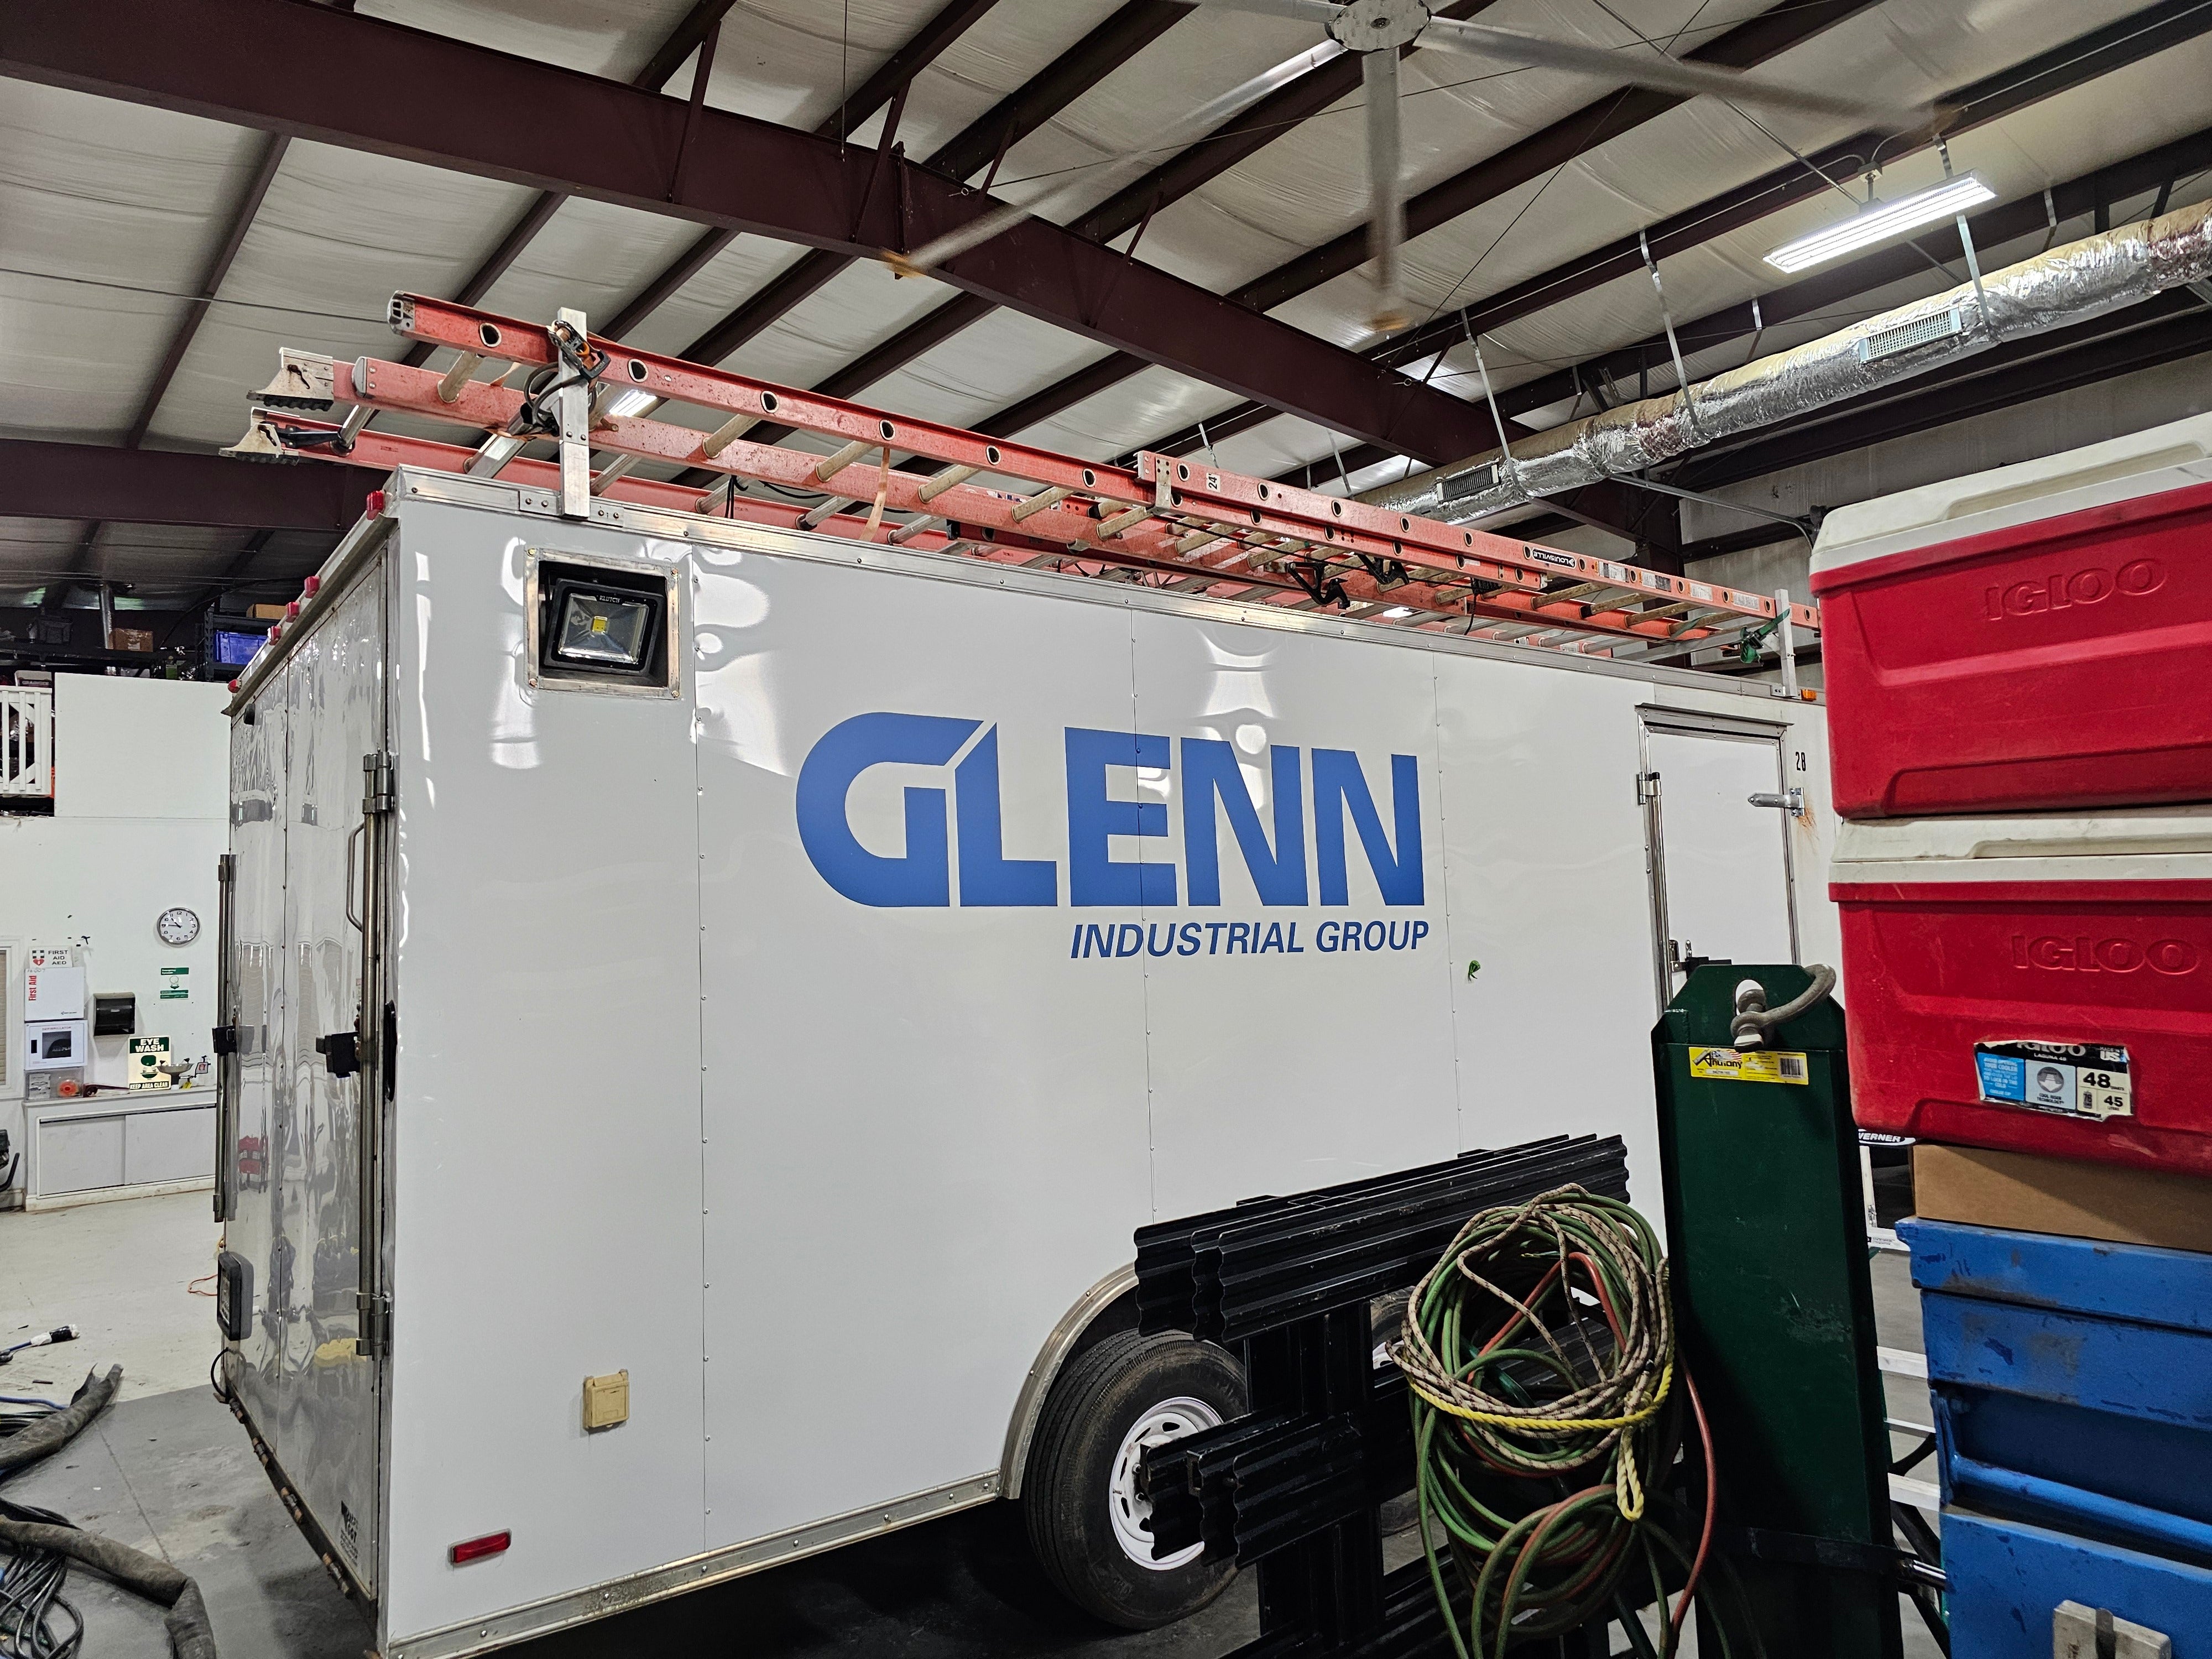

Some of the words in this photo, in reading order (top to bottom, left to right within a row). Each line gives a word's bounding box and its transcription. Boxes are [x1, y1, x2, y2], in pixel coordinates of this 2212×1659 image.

[1533, 551, 1569, 565] LOUISVILLE
[1985, 557, 2167, 620] IGLOO
[1795, 752, 1806, 771] 28
[795, 712, 1425, 907] GLENN
[1070, 922, 1305, 959] INDUSTRIAL
[1316, 920, 1429, 952] GROUP
[2011, 935, 2201, 975] IGLOO
[28, 987, 36, 1001] First
[2083, 1072, 2111, 1088] 48
[2104, 1095, 2123, 1107] 45
